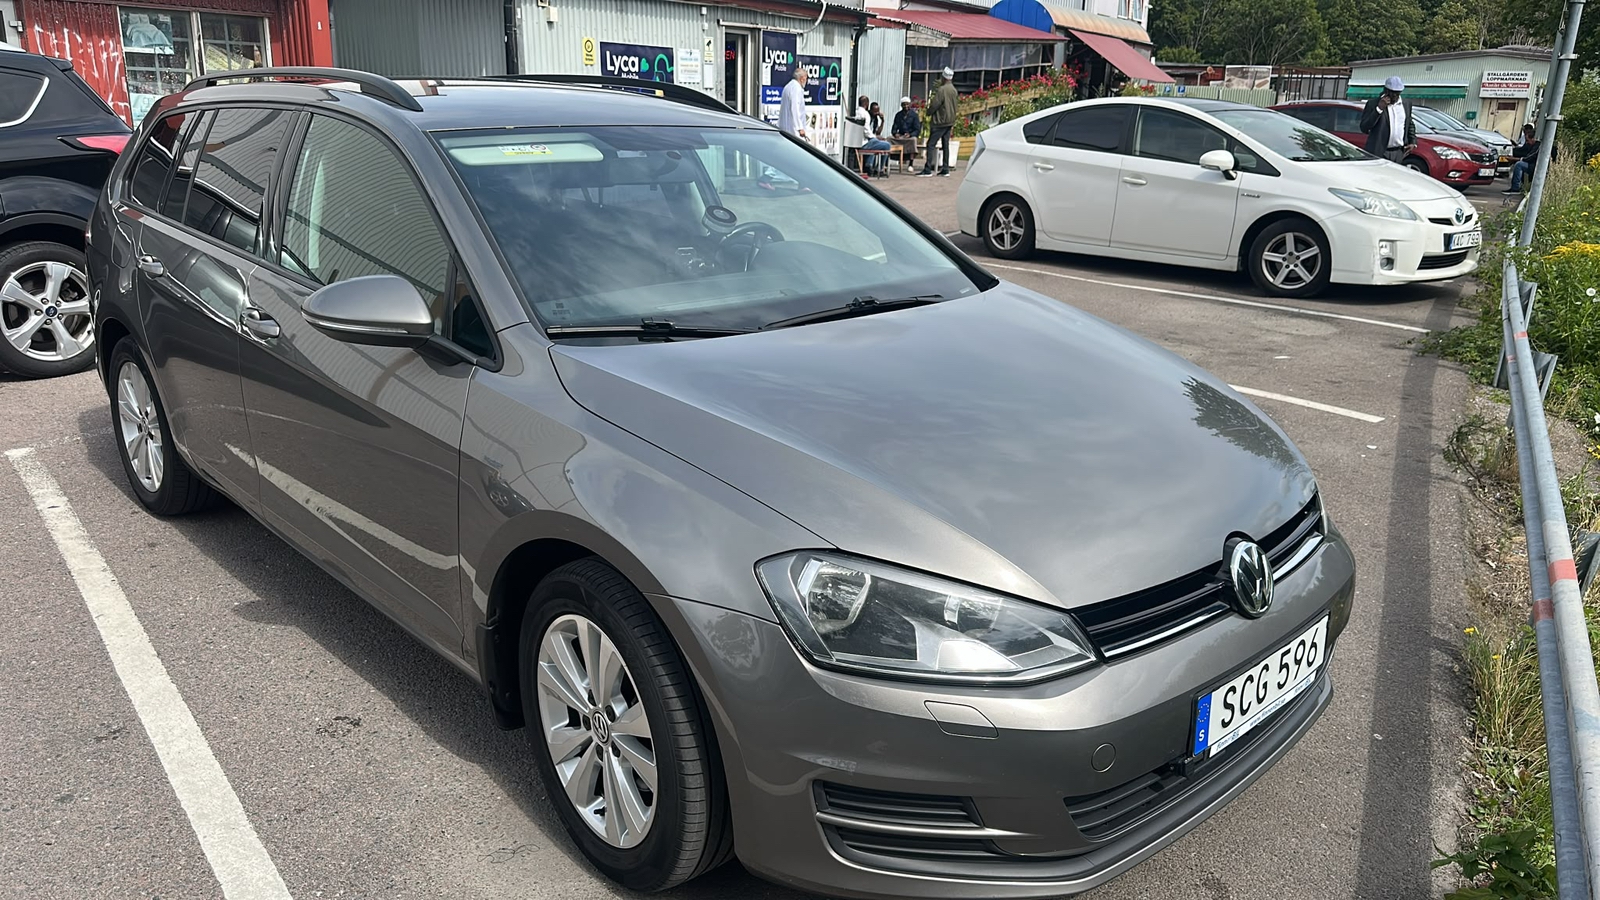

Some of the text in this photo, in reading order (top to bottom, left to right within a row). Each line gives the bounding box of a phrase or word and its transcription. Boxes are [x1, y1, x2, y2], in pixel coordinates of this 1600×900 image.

[605, 50, 639, 75] Lyca
[765, 46, 787, 67] Lyca
[1453, 235, 1464, 247] KAC
[1221, 663, 1270, 729] SCG
[1277, 627, 1318, 691] 596
[1198, 728, 1205, 742] S
